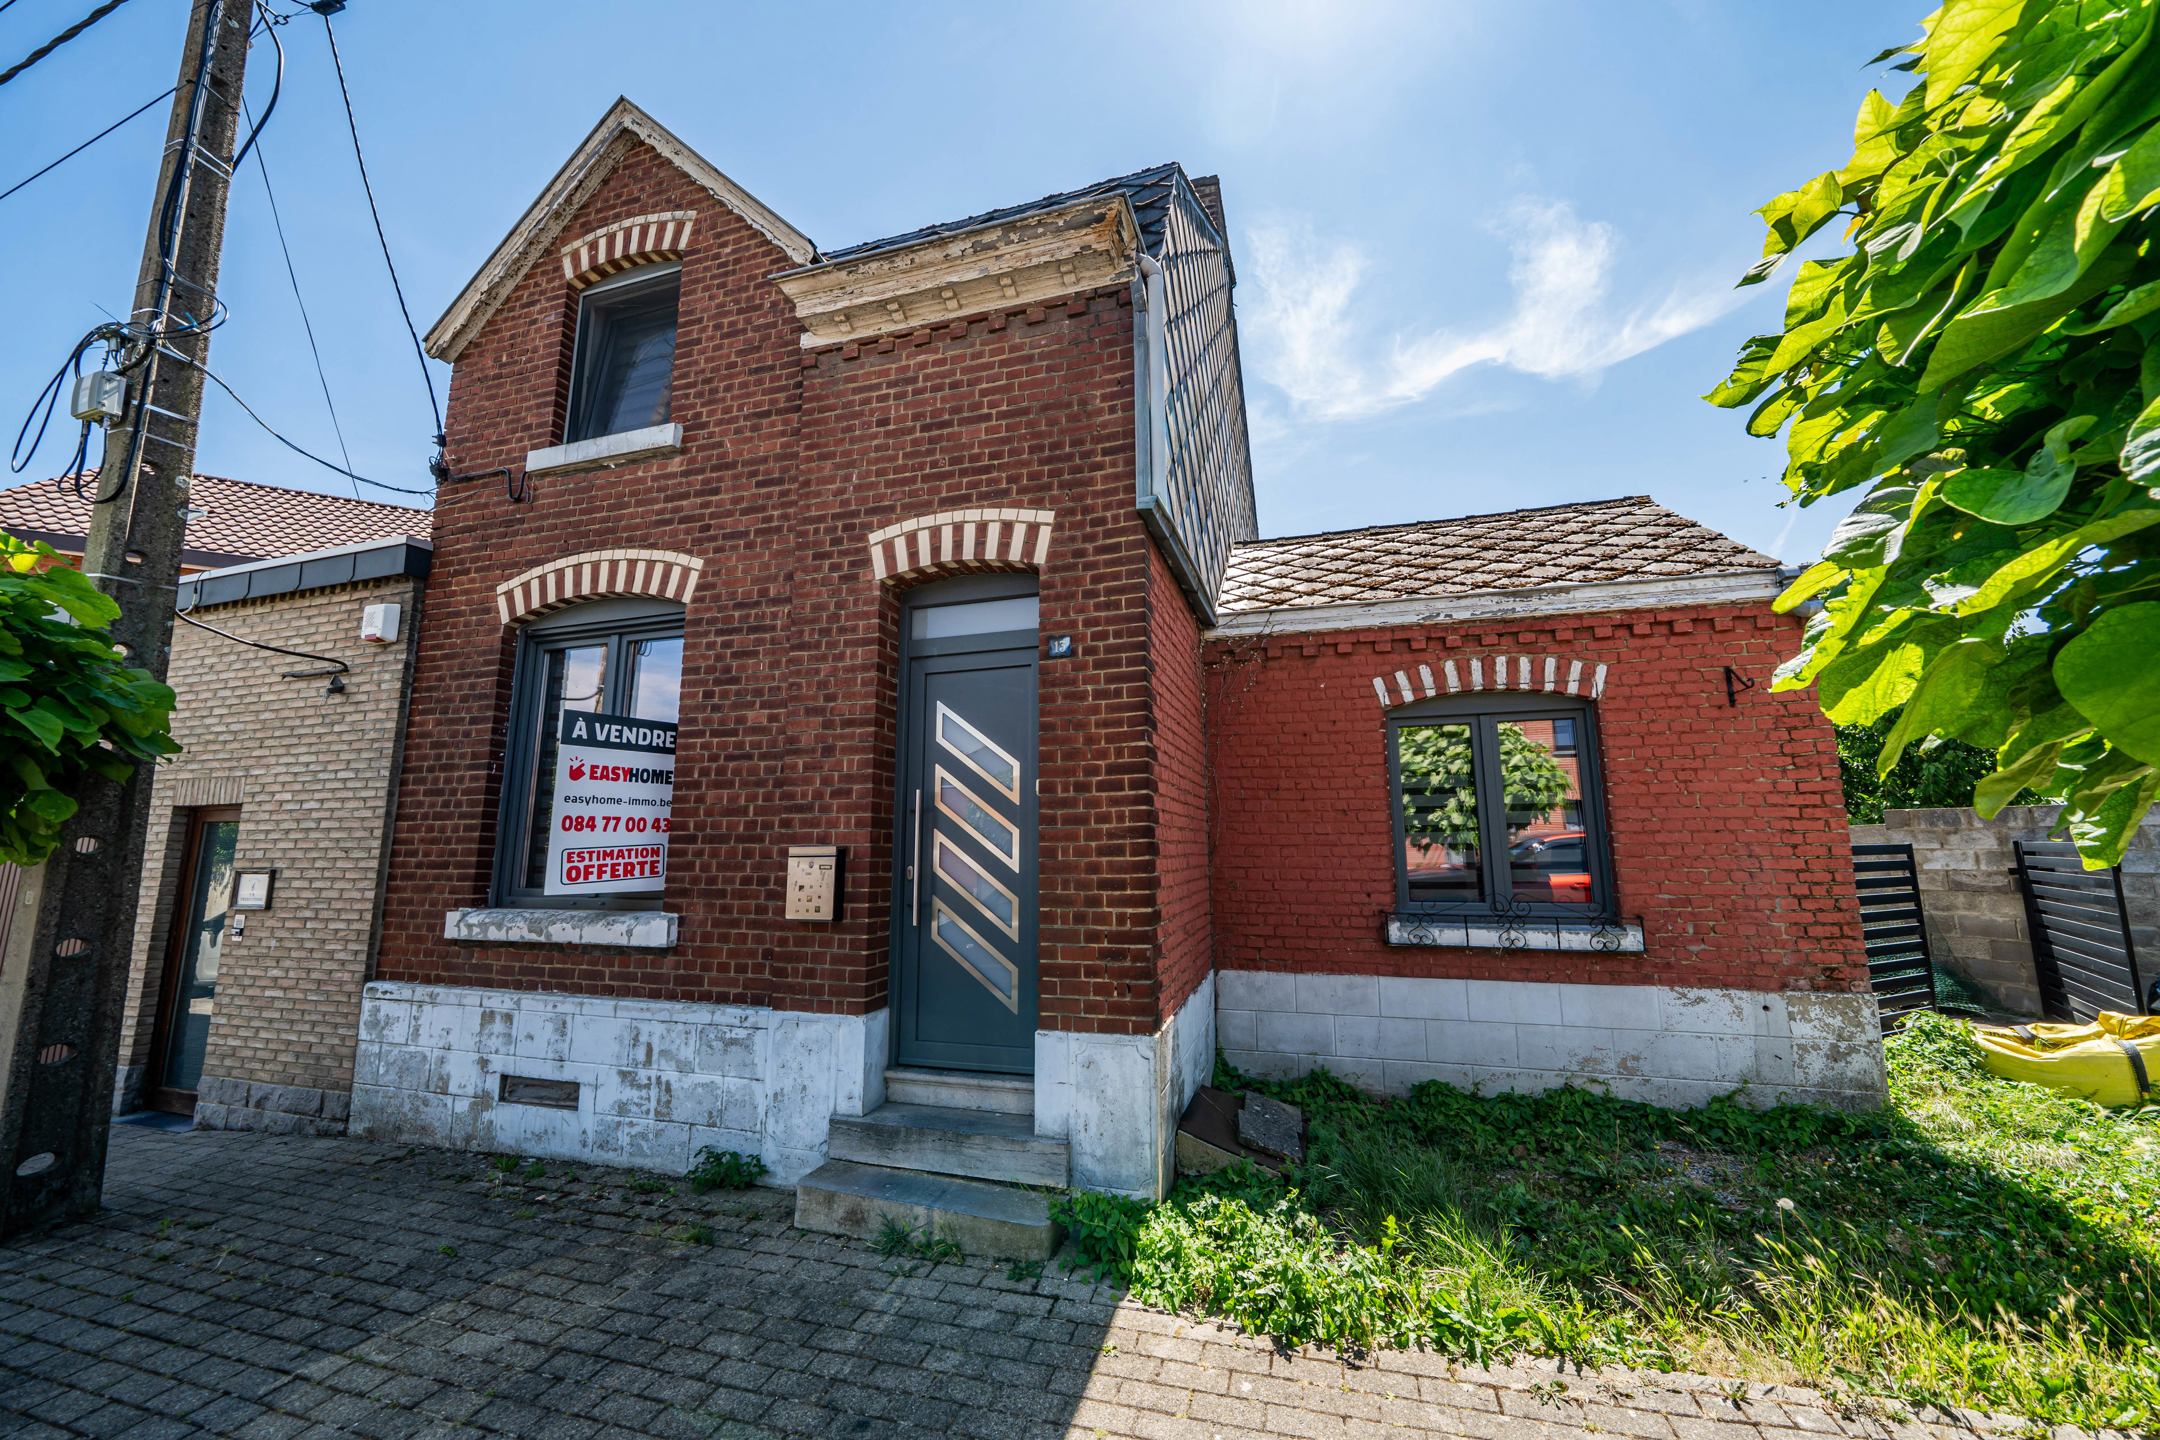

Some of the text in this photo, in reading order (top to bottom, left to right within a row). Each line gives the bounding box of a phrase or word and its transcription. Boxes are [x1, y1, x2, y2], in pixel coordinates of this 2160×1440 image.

[1054, 640, 1066, 653] 13
[572, 717, 676, 748] À VENDRE
[589, 765, 674, 785] EASYHOME
[564, 794, 672, 808] easyhome-immo.be
[561, 815, 671, 833] 084 77 00 43
[566, 847, 660, 863] ESTIMATION
[566, 860, 660, 882] OFFERTE
